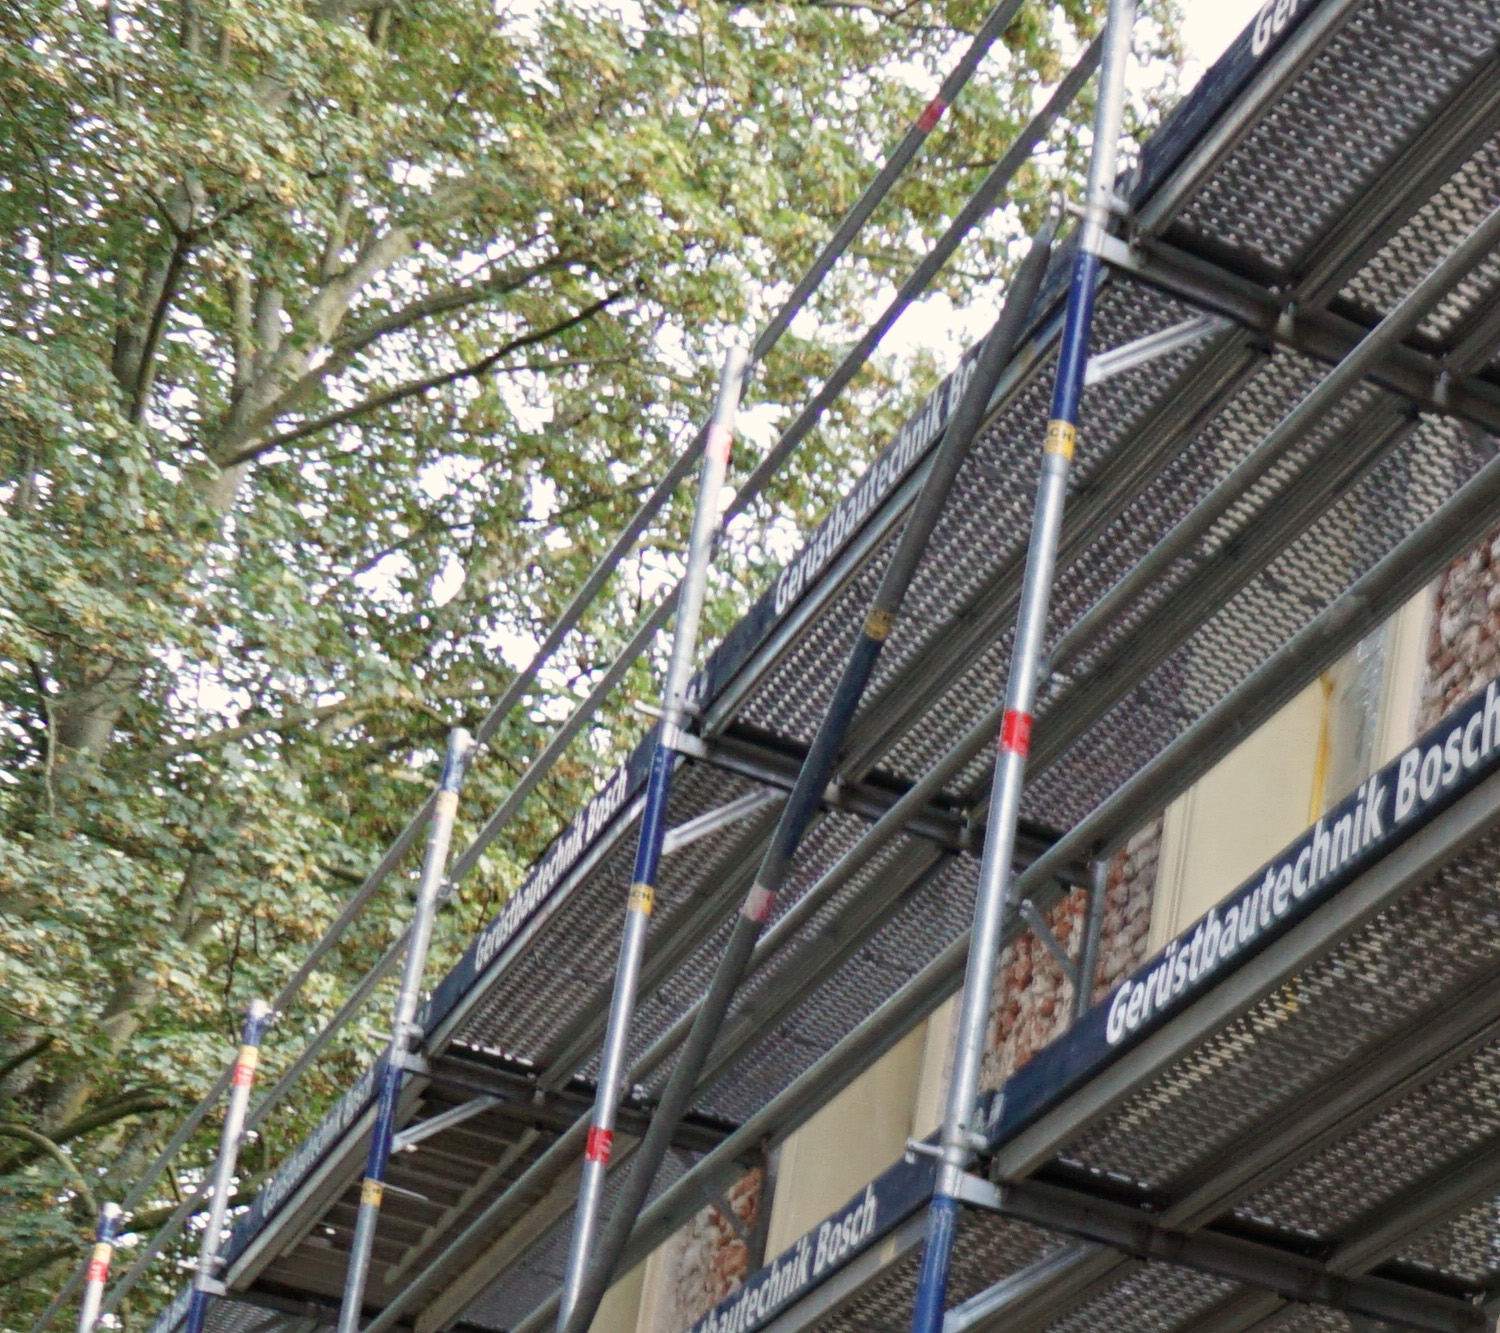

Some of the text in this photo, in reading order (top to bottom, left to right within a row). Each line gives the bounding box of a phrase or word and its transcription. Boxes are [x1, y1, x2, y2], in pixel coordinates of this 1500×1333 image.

[586, 764, 628, 843] Bosch
[1106, 774, 1388, 1045] Gerüstbautechnik
[813, 1183, 878, 1276] Bosch
